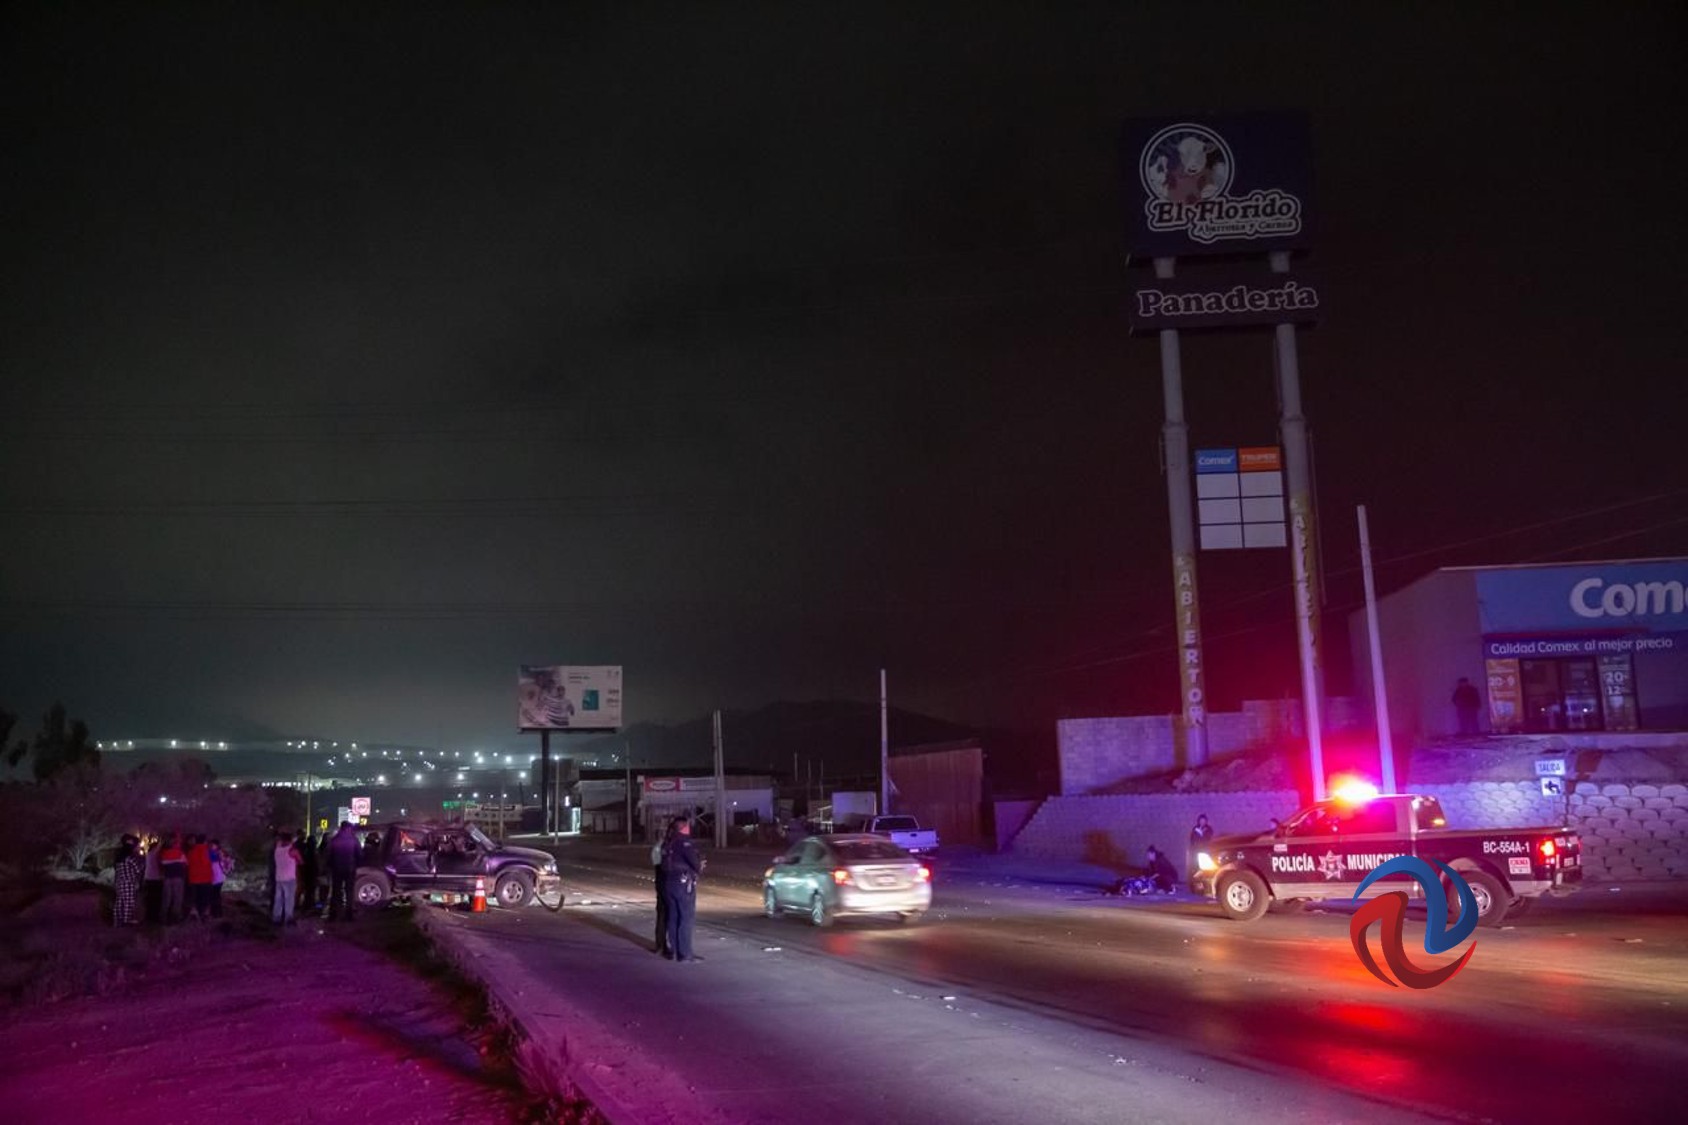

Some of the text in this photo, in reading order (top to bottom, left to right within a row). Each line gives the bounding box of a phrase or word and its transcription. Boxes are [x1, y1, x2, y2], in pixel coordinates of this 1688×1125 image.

[1153, 197, 1293, 223] El Florido
[1137, 282, 1319, 317] Panadería
[1570, 577, 1688, 618] Com
[1490, 637, 1674, 655] Calidad Comex al mejor precio
[1482, 841, 1530, 854] BC-554A-1
[1271, 853, 1316, 872] POLICÍA
